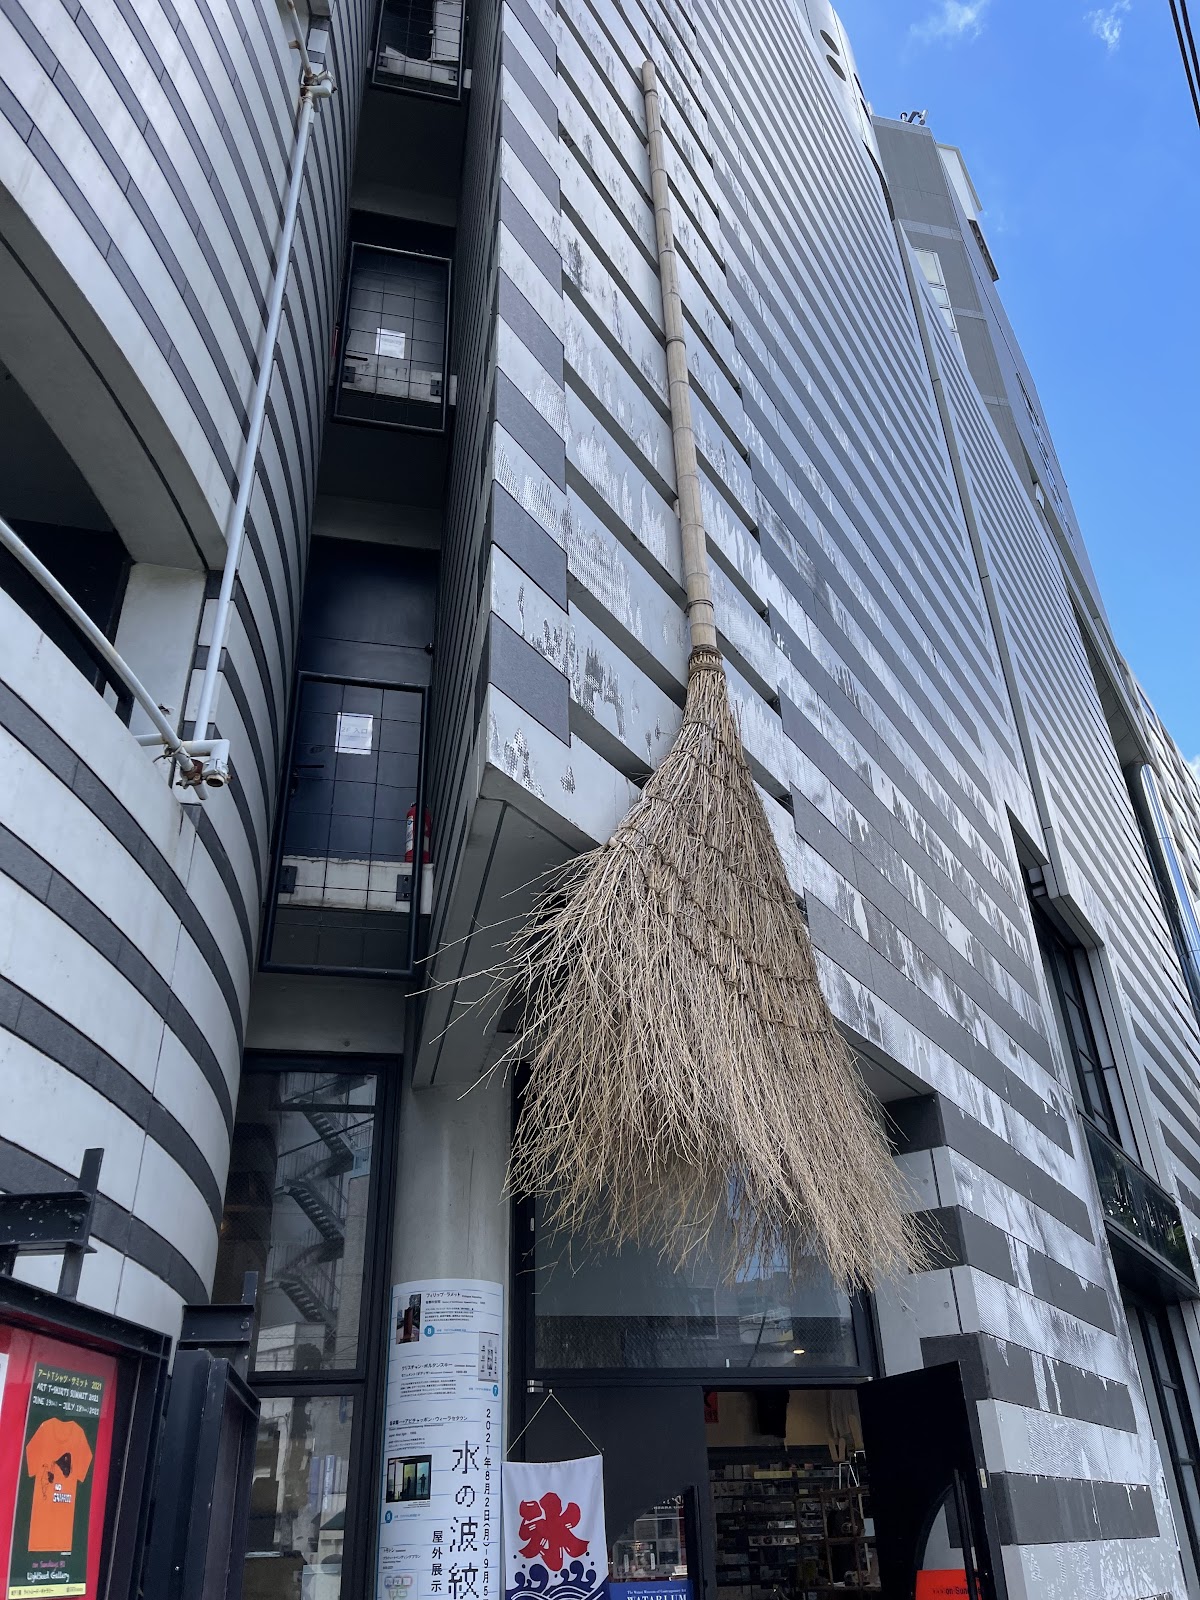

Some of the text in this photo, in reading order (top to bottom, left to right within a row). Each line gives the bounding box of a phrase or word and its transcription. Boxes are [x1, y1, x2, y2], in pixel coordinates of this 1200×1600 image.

[33, 1396, 45, 1405] JUNE
[63, 1402, 75, 1411] JULY
[37, 1382, 99, 1402] ART T-SHIRTS SUMMIT 2021
[448, 1440, 480, 1600] 水の波紋
[518, 1492, 590, 1571] 氷
[50, 1571, 70, 1583] Gallery
[431, 1530, 443, 1592] 屋外展示
